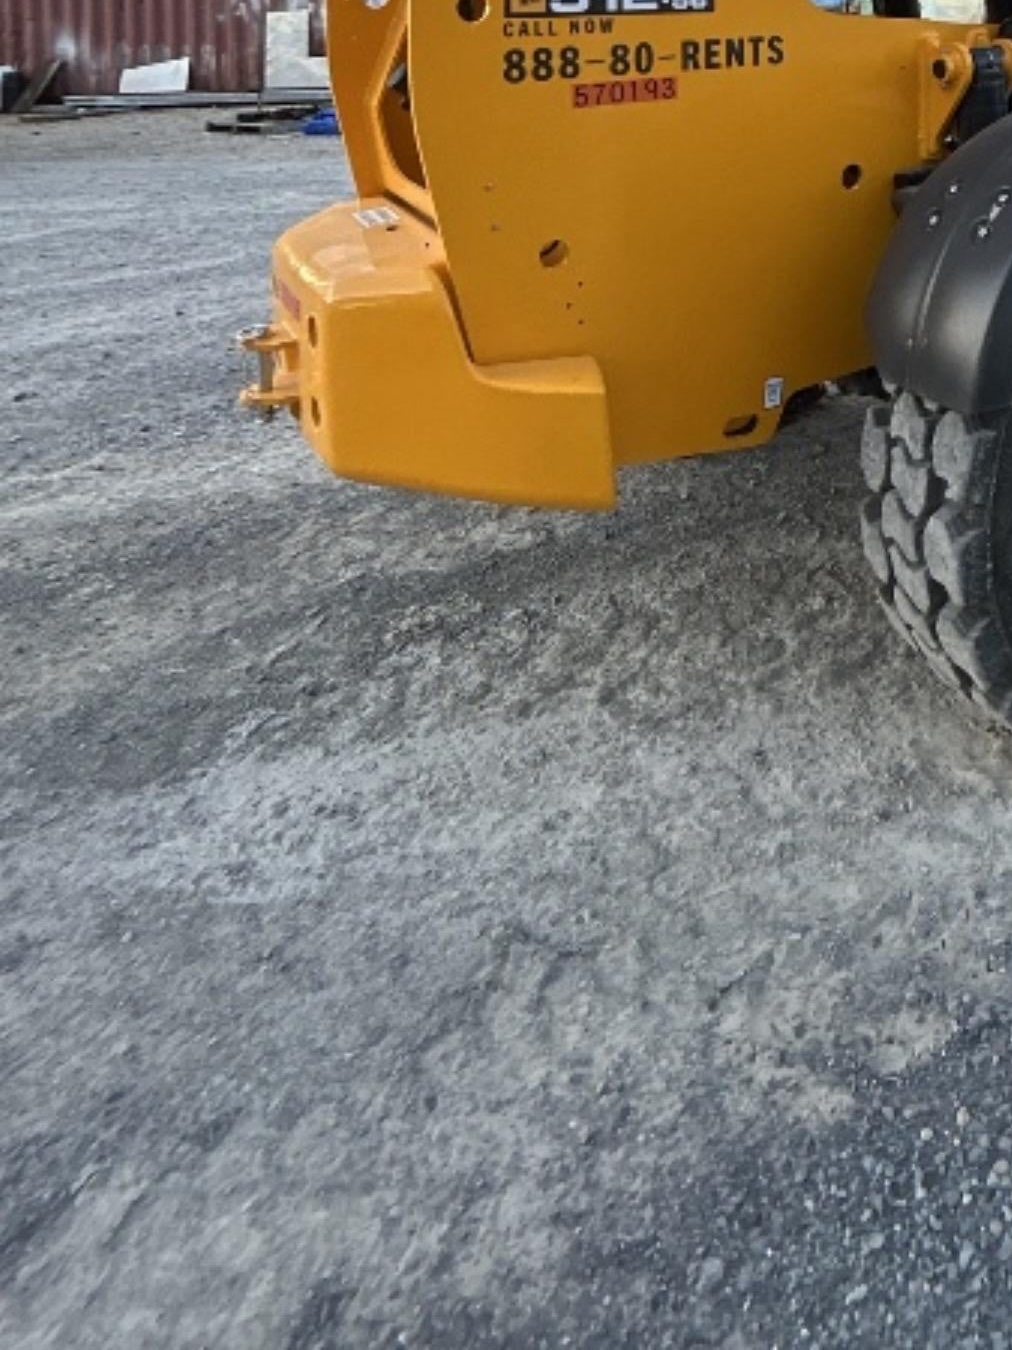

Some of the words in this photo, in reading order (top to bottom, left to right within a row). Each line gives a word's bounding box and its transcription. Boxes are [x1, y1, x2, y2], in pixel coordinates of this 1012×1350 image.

[503, 19, 558, 38] CALL
[569, 17, 615, 35] NOW
[503, 35, 785, 85] 888-80-RENTS
[573, 77, 678, 109] 570193
